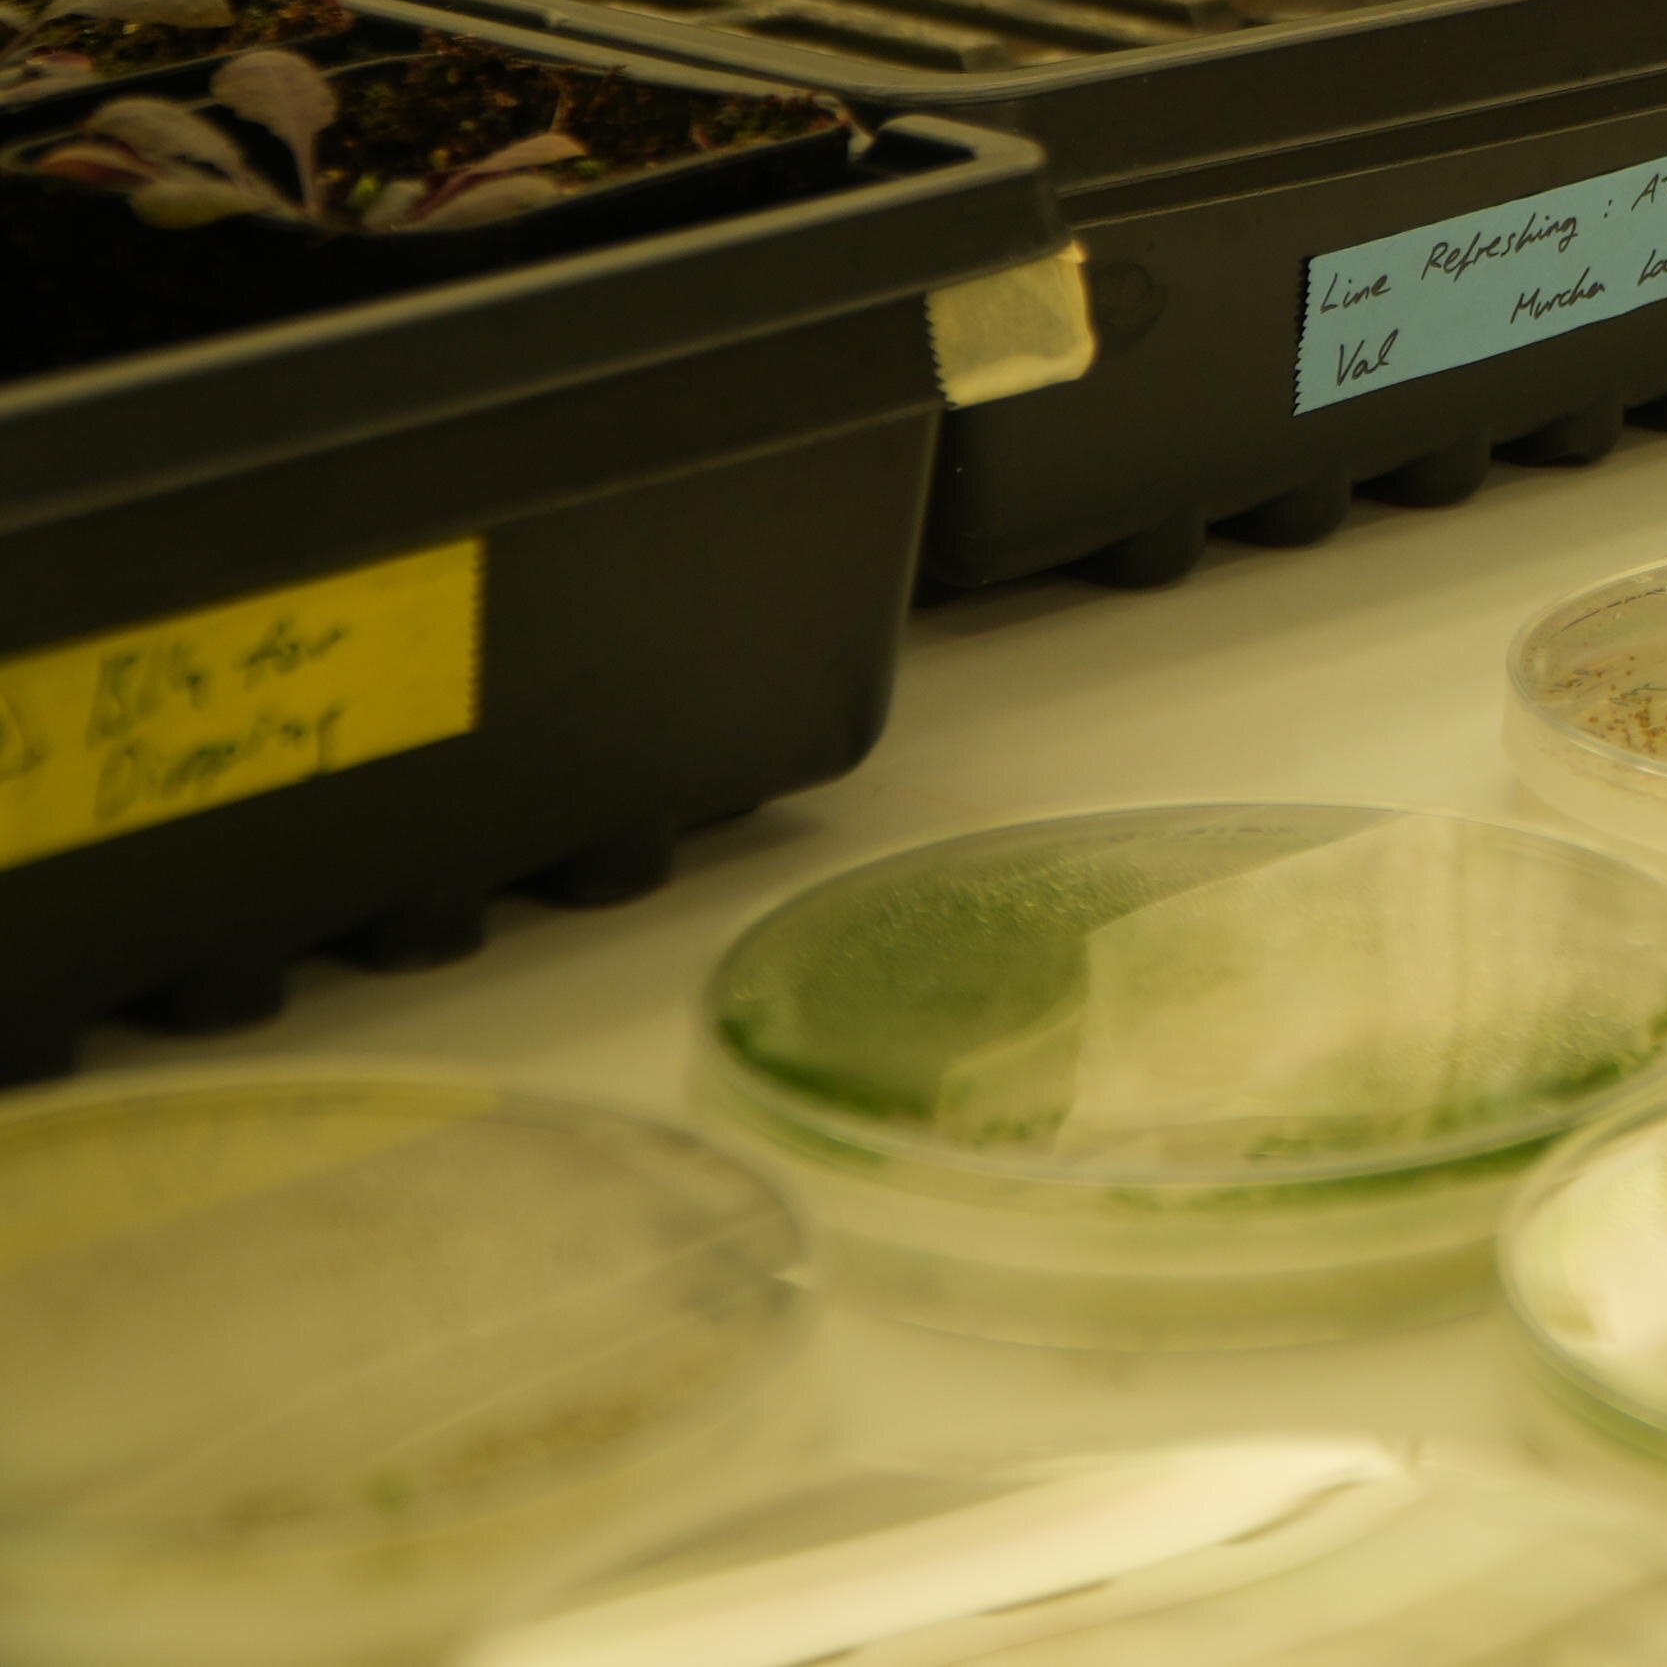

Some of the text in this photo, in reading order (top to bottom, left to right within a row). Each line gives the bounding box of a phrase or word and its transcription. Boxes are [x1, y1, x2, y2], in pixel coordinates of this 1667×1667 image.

[1319, 272, 1392, 315] Line
[1420, 212, 1580, 282] Refreshing
[1335, 328, 1400, 387] Val
